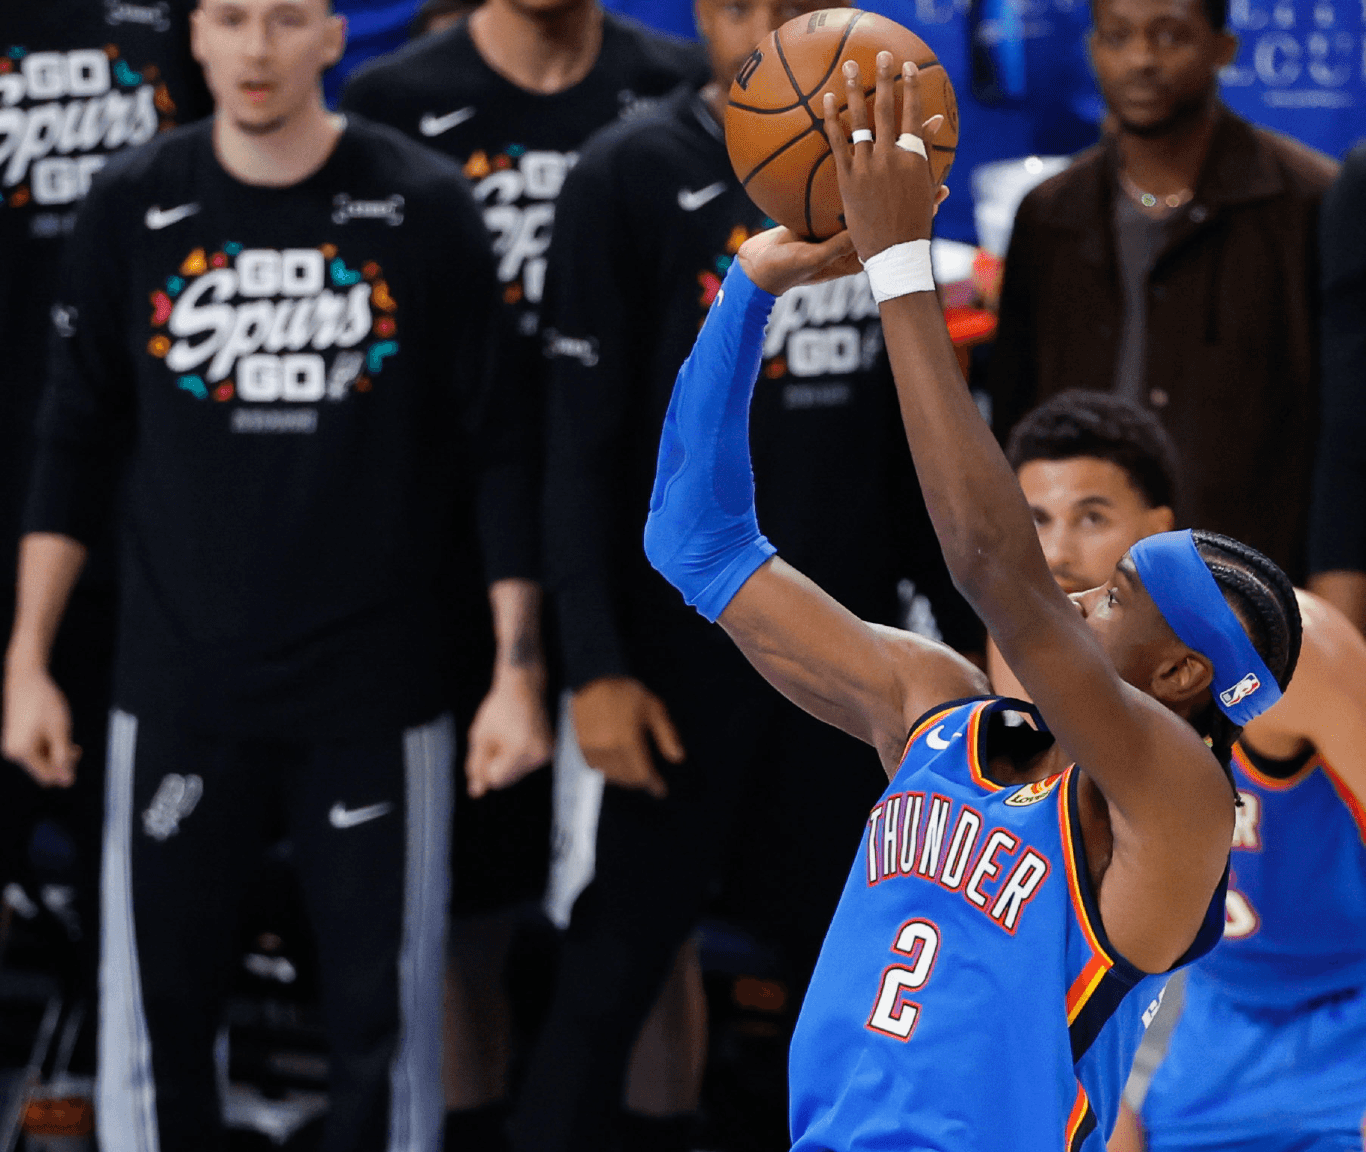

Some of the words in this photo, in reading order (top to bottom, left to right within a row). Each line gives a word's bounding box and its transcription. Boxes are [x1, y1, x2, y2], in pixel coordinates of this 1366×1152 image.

[21, 49, 111, 100] GO
[236, 247, 325, 299] GO
[165, 266, 373, 384] Spurs
[788, 324, 861, 376] GO
[236, 352, 326, 403] GO
[867, 790, 1052, 937] THUNDER
[864, 916, 942, 1043] 2
